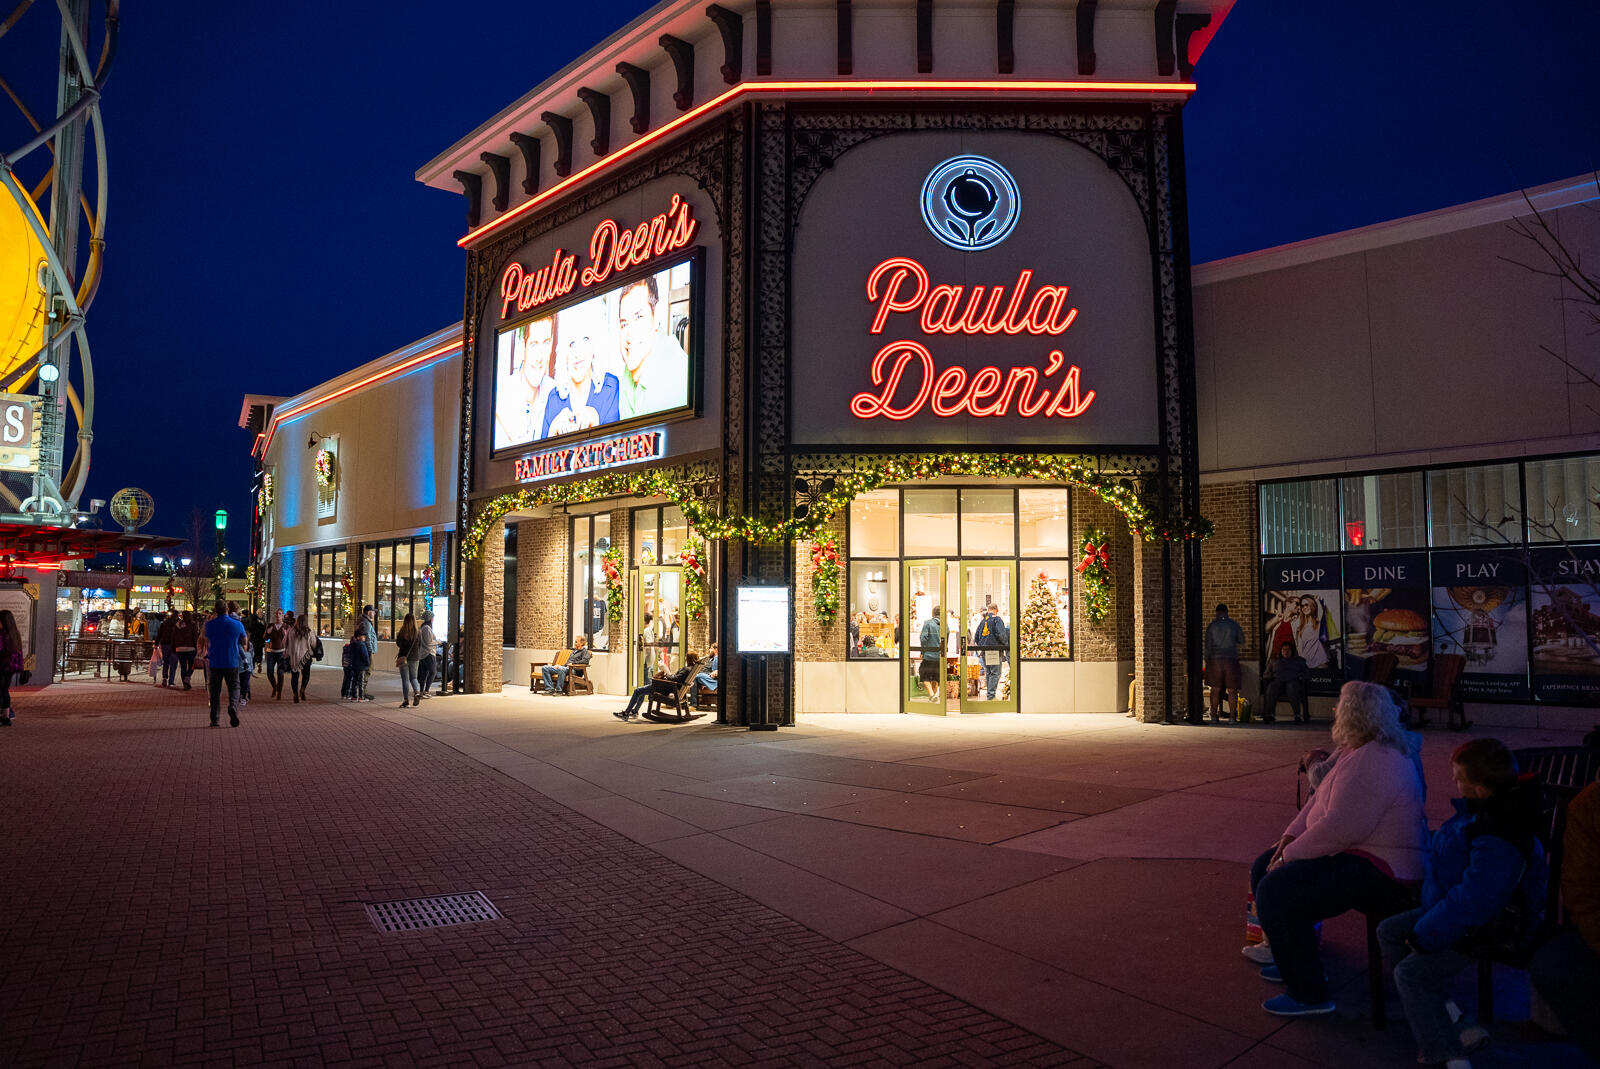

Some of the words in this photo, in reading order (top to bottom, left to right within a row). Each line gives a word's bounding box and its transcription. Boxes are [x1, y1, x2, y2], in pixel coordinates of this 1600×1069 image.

[500, 248, 578, 320] Paula
[580, 192, 696, 288] Deen's
[866, 256, 1079, 336] Paula
[850, 339, 1096, 421] Deen's
[3, 405, 25, 443] S
[514, 448, 571, 481] FAMILY
[572, 431, 657, 470] KITCHEN
[1281, 568, 1326, 583] SHOP
[1364, 565, 1407, 581] DINE
[1455, 562, 1501, 579] PLAY
[1558, 558, 1600, 576] STAY
[151, 585, 165, 593] NAIL
